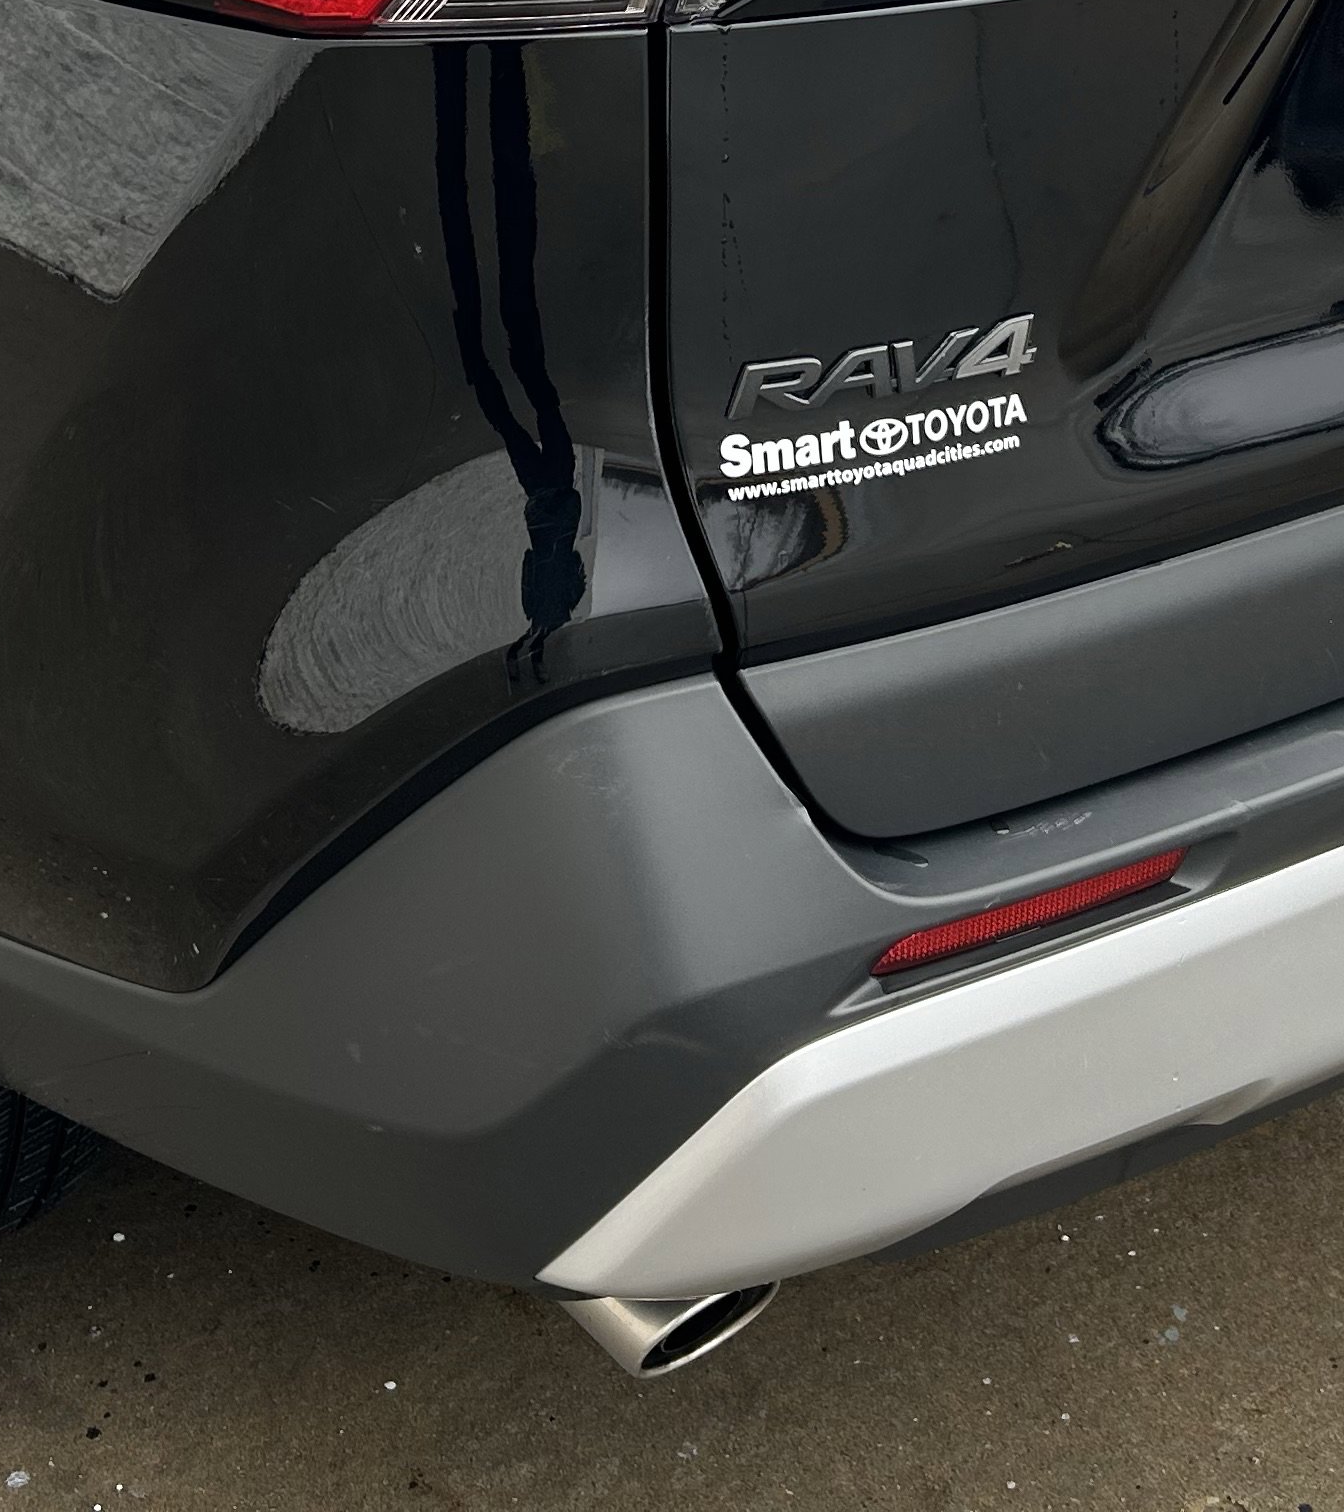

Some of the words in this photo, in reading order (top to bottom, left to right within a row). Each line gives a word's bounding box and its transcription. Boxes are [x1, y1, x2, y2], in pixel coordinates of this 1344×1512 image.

[724, 312, 1037, 420] RAV4
[720, 420, 856, 478] Smart
[906, 393, 1027, 445] TOYOTA
[728, 434, 1020, 502] www.smarttoyotaquadcities.com
